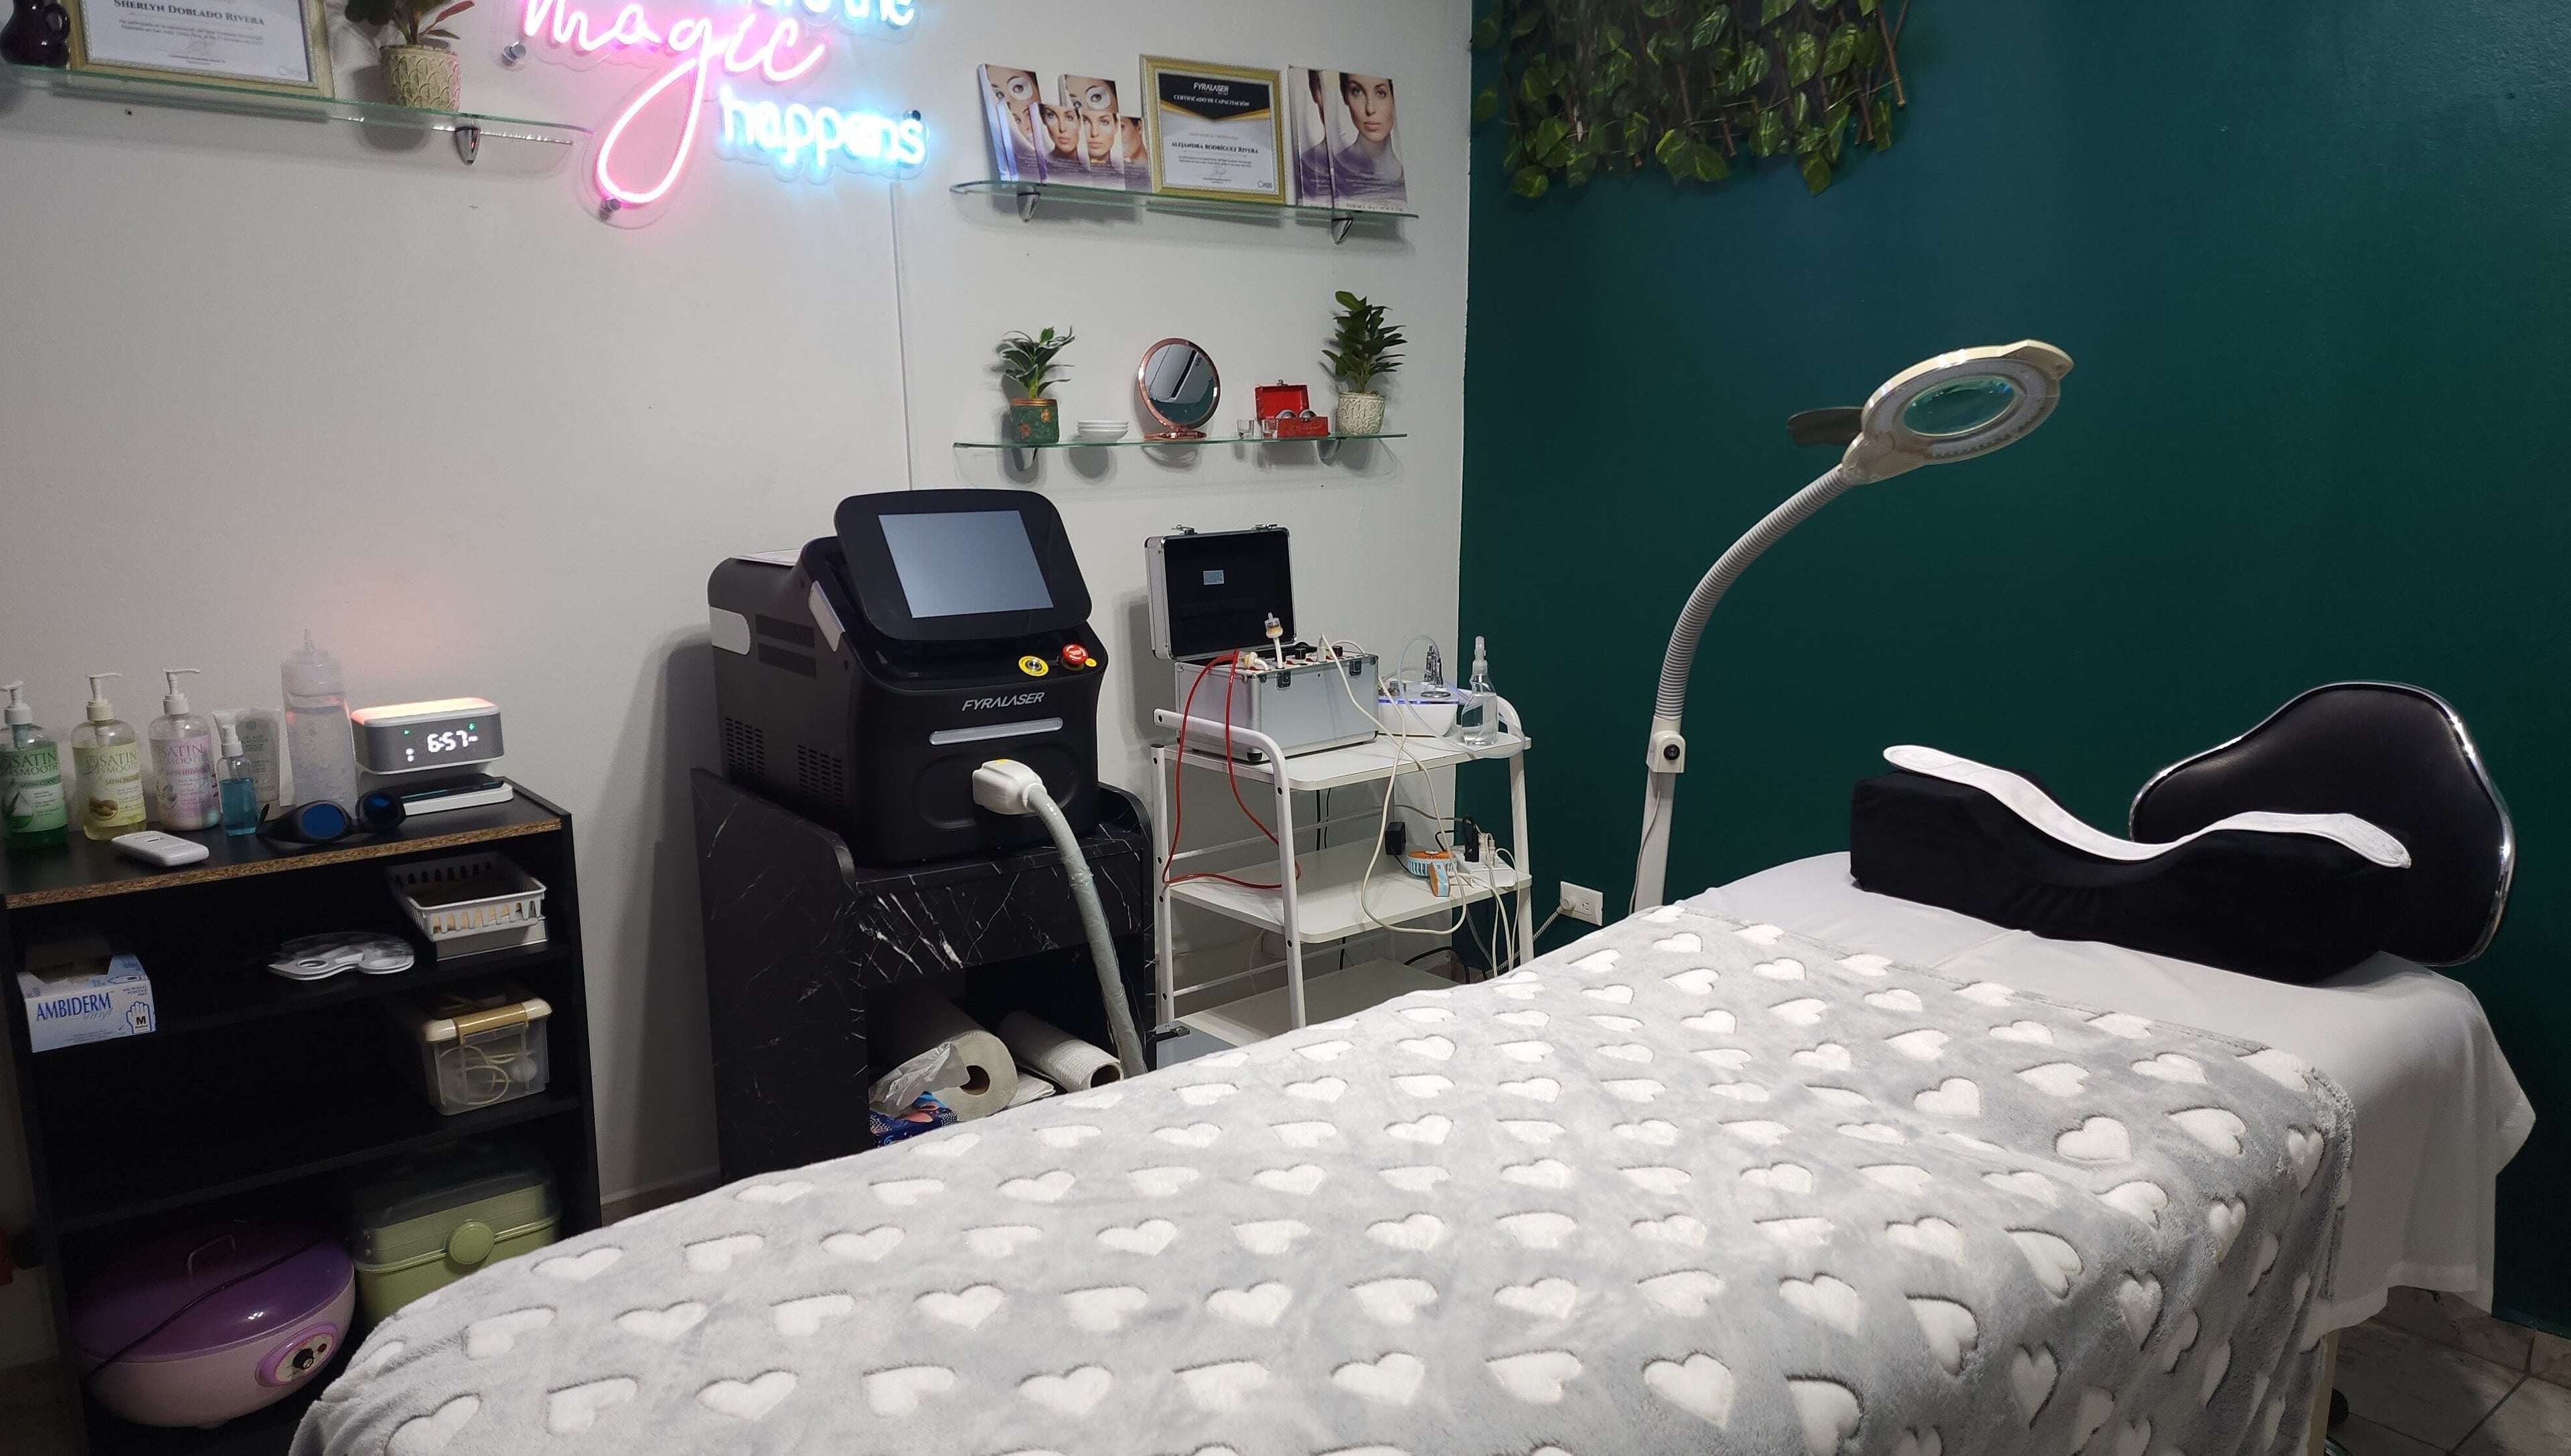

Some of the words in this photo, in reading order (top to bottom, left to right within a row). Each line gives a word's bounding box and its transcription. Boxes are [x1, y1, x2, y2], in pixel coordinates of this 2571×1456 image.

[114, 0, 165, 12] SHERLYN
[169, 5, 223, 19] DOBLADO
[226, 12, 264, 25] RIVERA
[1193, 82, 1229, 92] FYRALASER
[718, 85, 928, 167] happens
[1172, 141, 1204, 149] ALEJANDRA
[1238, 146, 1259, 154] RIVERA
[961, 692, 1045, 712] FYRALASER
[12, 752, 57, 768] SATIN
[98, 752, 137, 767] SATIN
[13, 764, 58, 777] SMOOTH
[36, 991, 111, 1022] AMBIDERM
[136, 1016, 147, 1026] M
